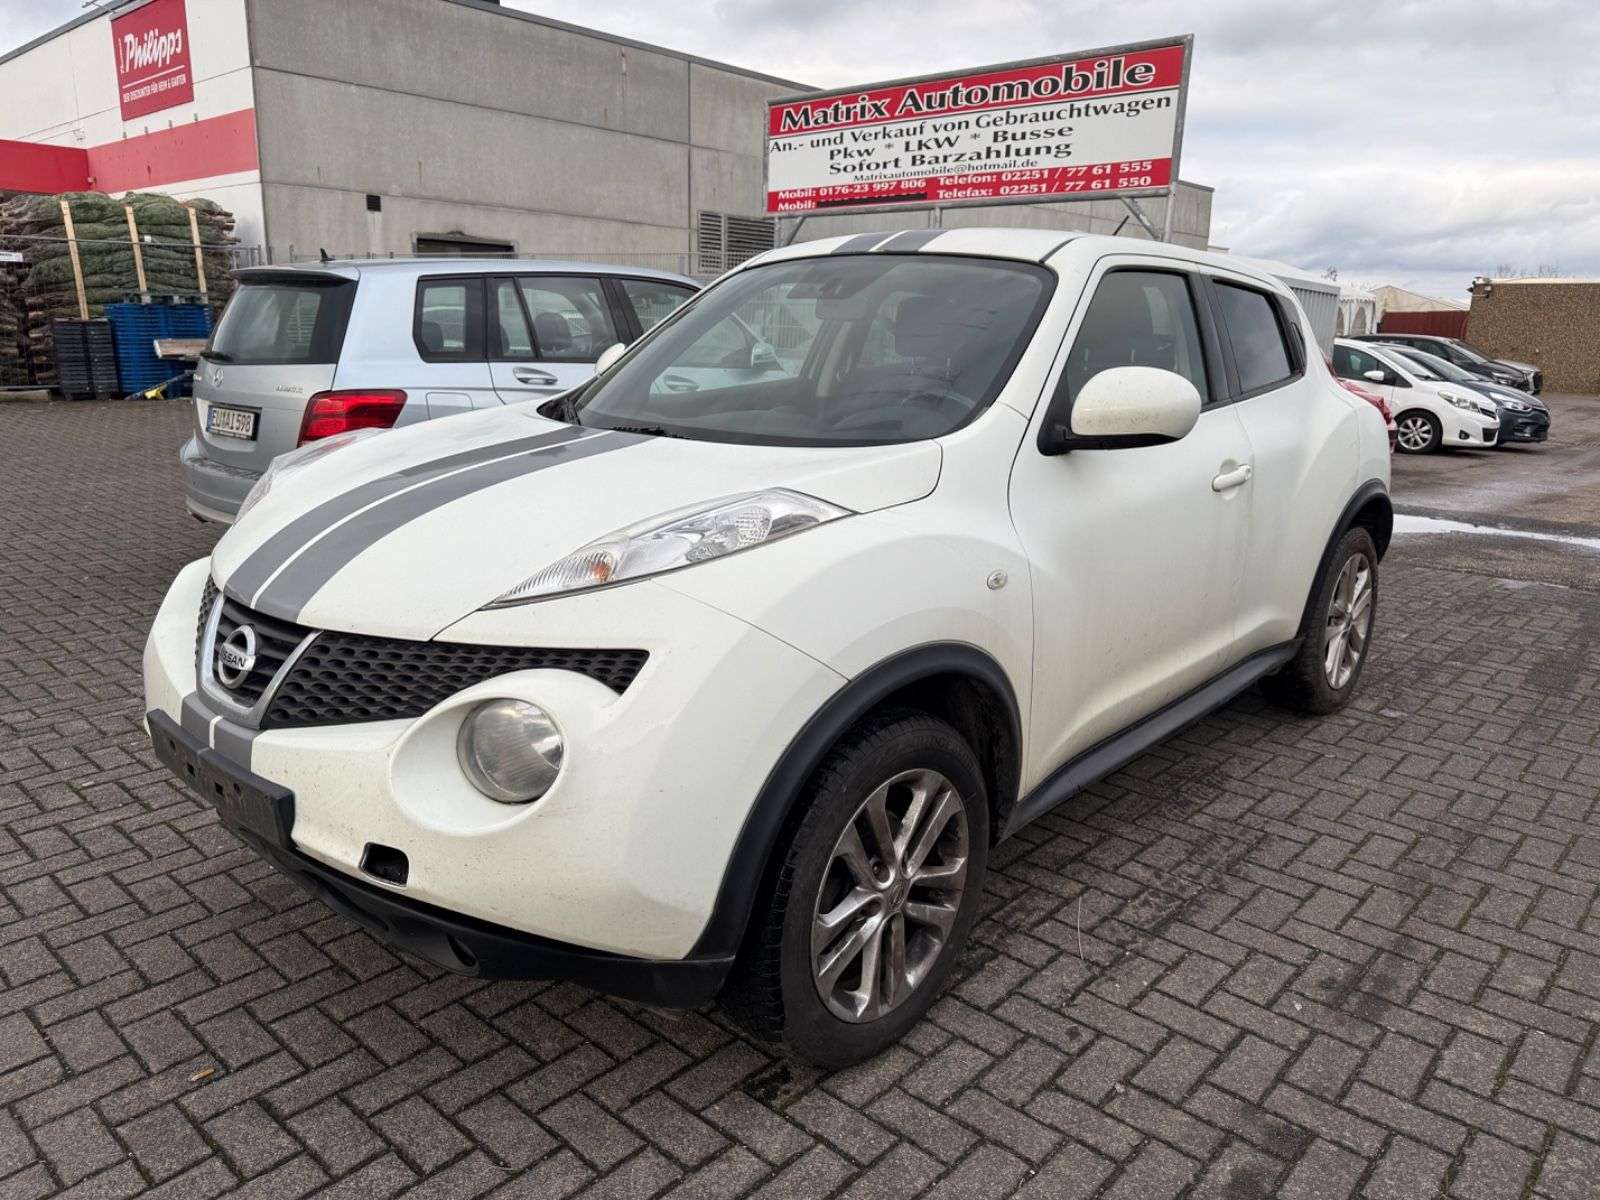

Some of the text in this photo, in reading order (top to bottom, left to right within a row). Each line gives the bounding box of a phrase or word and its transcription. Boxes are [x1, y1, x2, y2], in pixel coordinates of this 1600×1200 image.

[124, 28, 183, 73] Philipps
[781, 57, 1155, 131] Matrix Automobile
[810, 132, 844, 148] und
[851, 121, 926, 144] Verkauf
[932, 118, 969, 134] von
[975, 95, 1171, 128] Gebrauchtwagen
[829, 147, 876, 161] Pkw
[904, 135, 960, 153] LKW
[992, 125, 1073, 143] Busse
[829, 142, 1073, 175] Sofort Barzahlung
[853, 158, 1038, 182] Matrixautomobile@hotmail.de
[936, 187, 993, 200] Telefax:
[1000, 184, 1047, 196] 02251
[1064, 180, 1084, 192] 77
[1091, 178, 1111, 189] 61
[1117, 176, 1152, 188] 550
[938, 173, 997, 186] Telefon:
[1001, 169, 1049, 182] 02251
[1066, 165, 1087, 177] 77
[1092, 163, 1113, 175] 61
[1119, 161, 1152, 173] 555
[778, 178, 927, 200] Mobil: 0176-23 997 806
[777, 200, 816, 212] Mobil:
